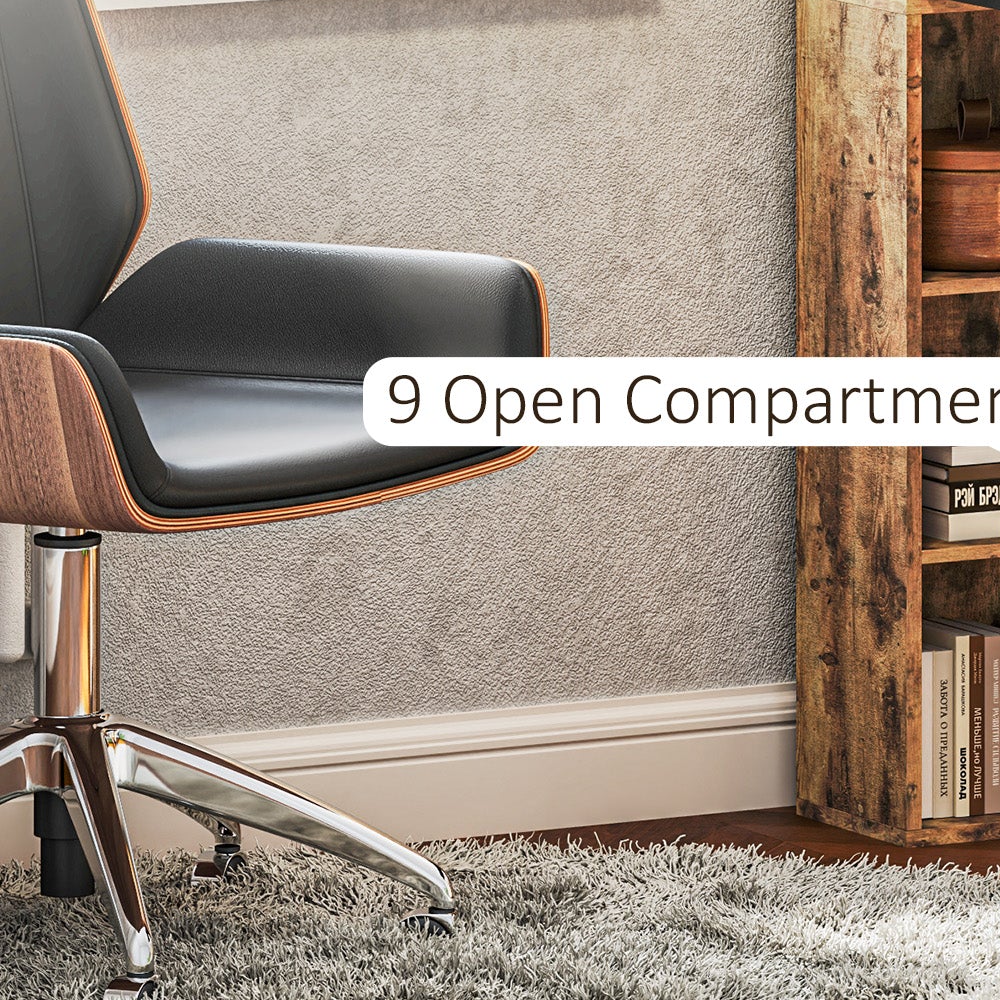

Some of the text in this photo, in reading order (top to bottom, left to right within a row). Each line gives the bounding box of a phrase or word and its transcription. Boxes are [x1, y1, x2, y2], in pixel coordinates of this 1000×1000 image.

[954, 484, 975, 508] РЭЙ
[940, 679, 948, 719] ЗАБОТА
[940, 731, 948, 797] ПРЕДАННЫХ
[959, 747, 967, 800] ШОКОЛАД
[973, 765, 982, 799] ЛУЧШЕ
